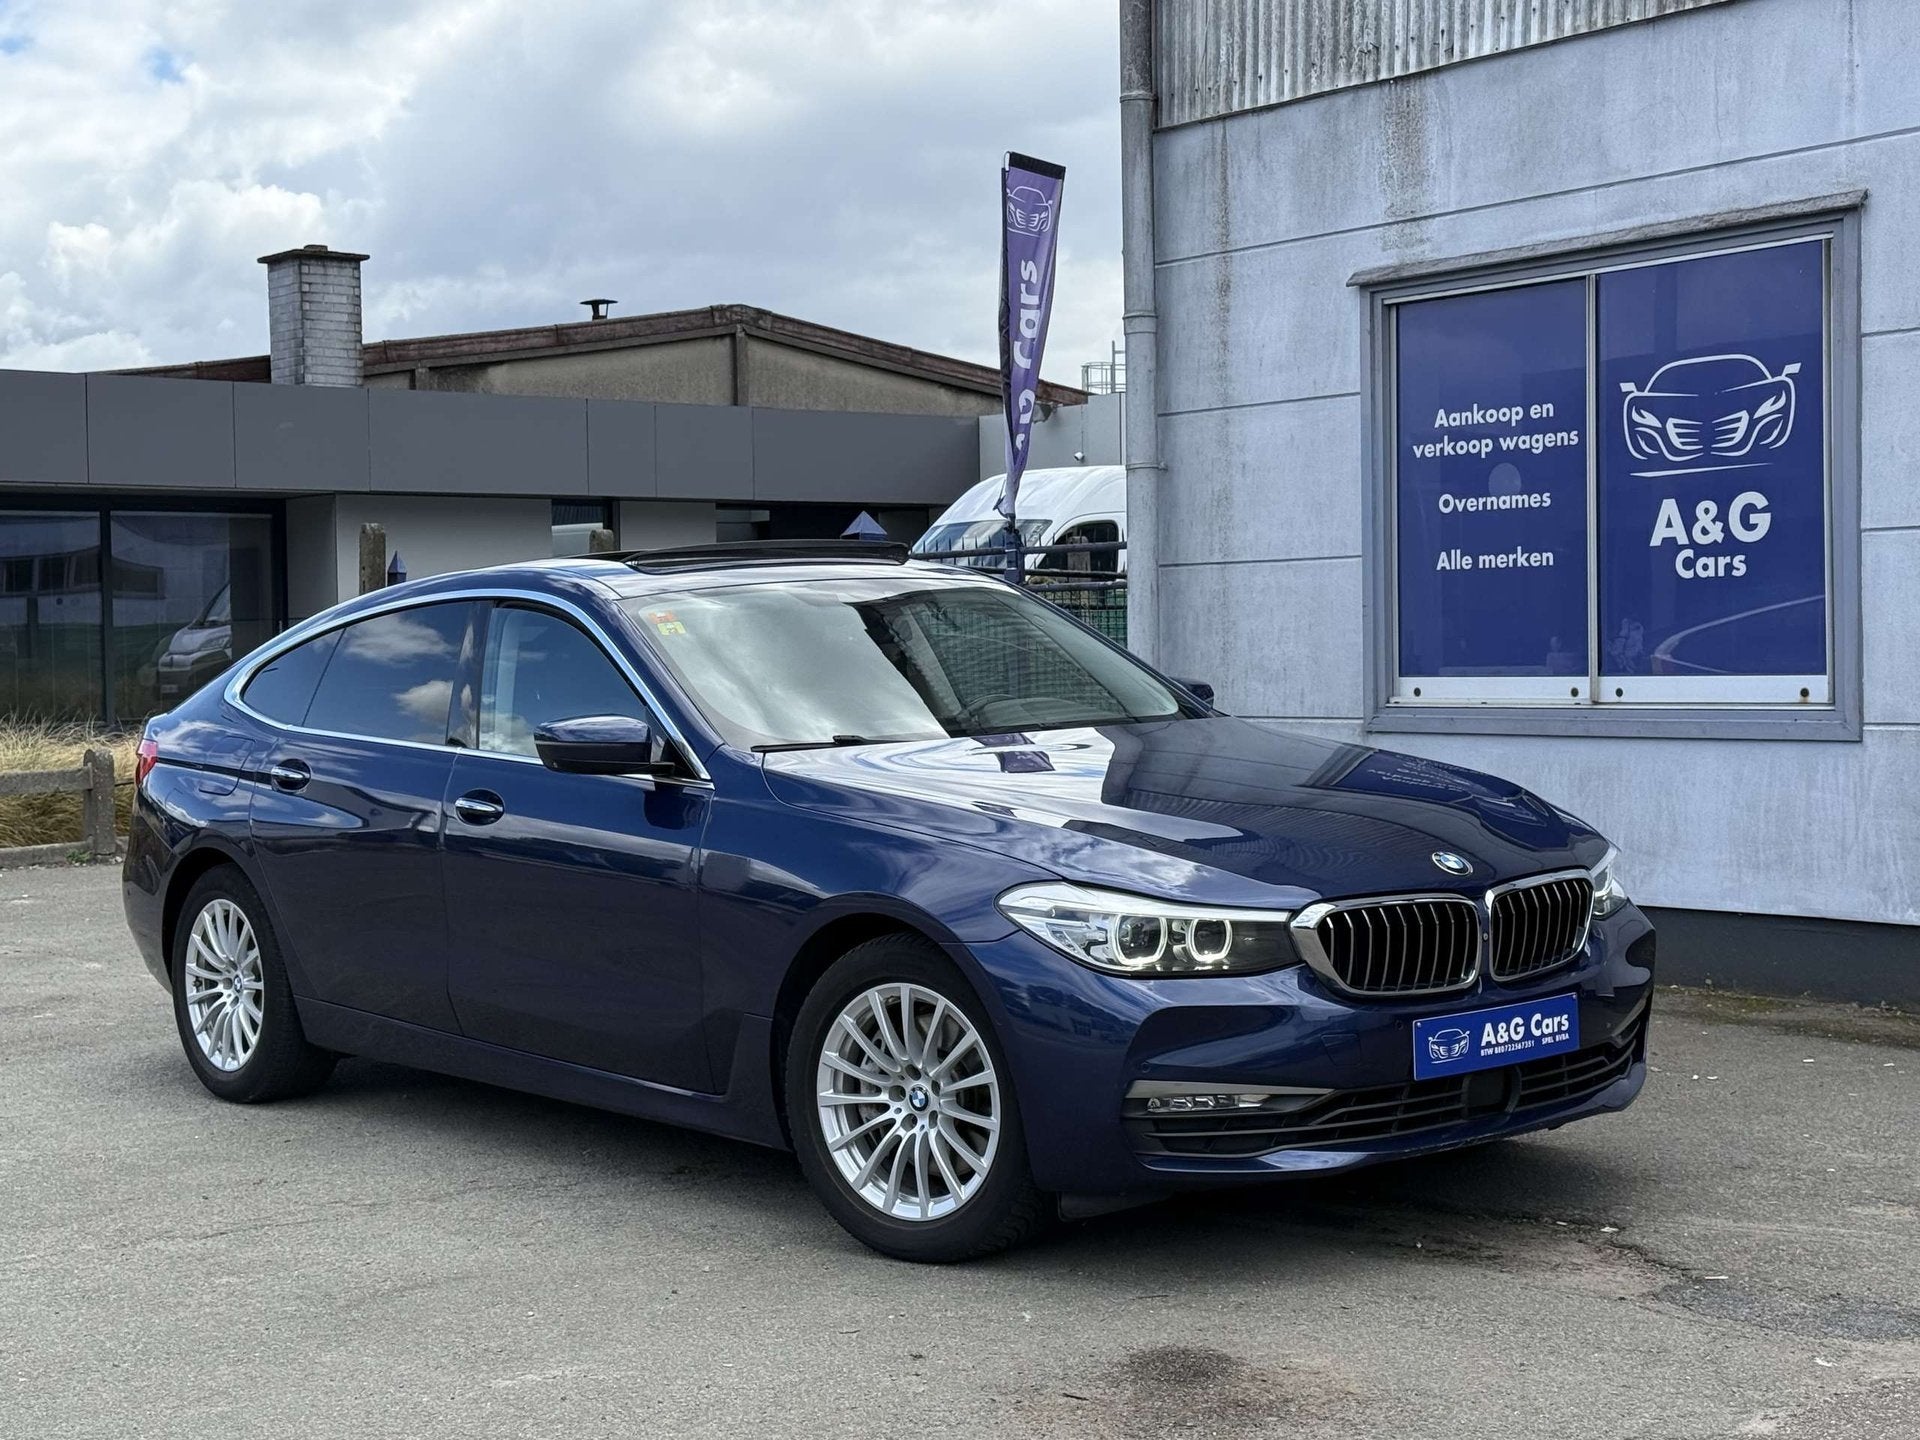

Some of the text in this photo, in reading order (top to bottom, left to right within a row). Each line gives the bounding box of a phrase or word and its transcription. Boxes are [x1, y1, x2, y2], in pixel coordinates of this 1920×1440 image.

[1434, 403, 1554, 428] Aankoop en
[1412, 430, 1579, 459] verkoop wagens
[1438, 492, 1551, 514] Overnames
[1650, 491, 1771, 547] A&G
[1436, 546, 1554, 571] Alle merken
[1675, 548, 1747, 579] Cars
[1480, 1013, 1570, 1047] A&G Cars
[1480, 1047, 1494, 1057] BTW
